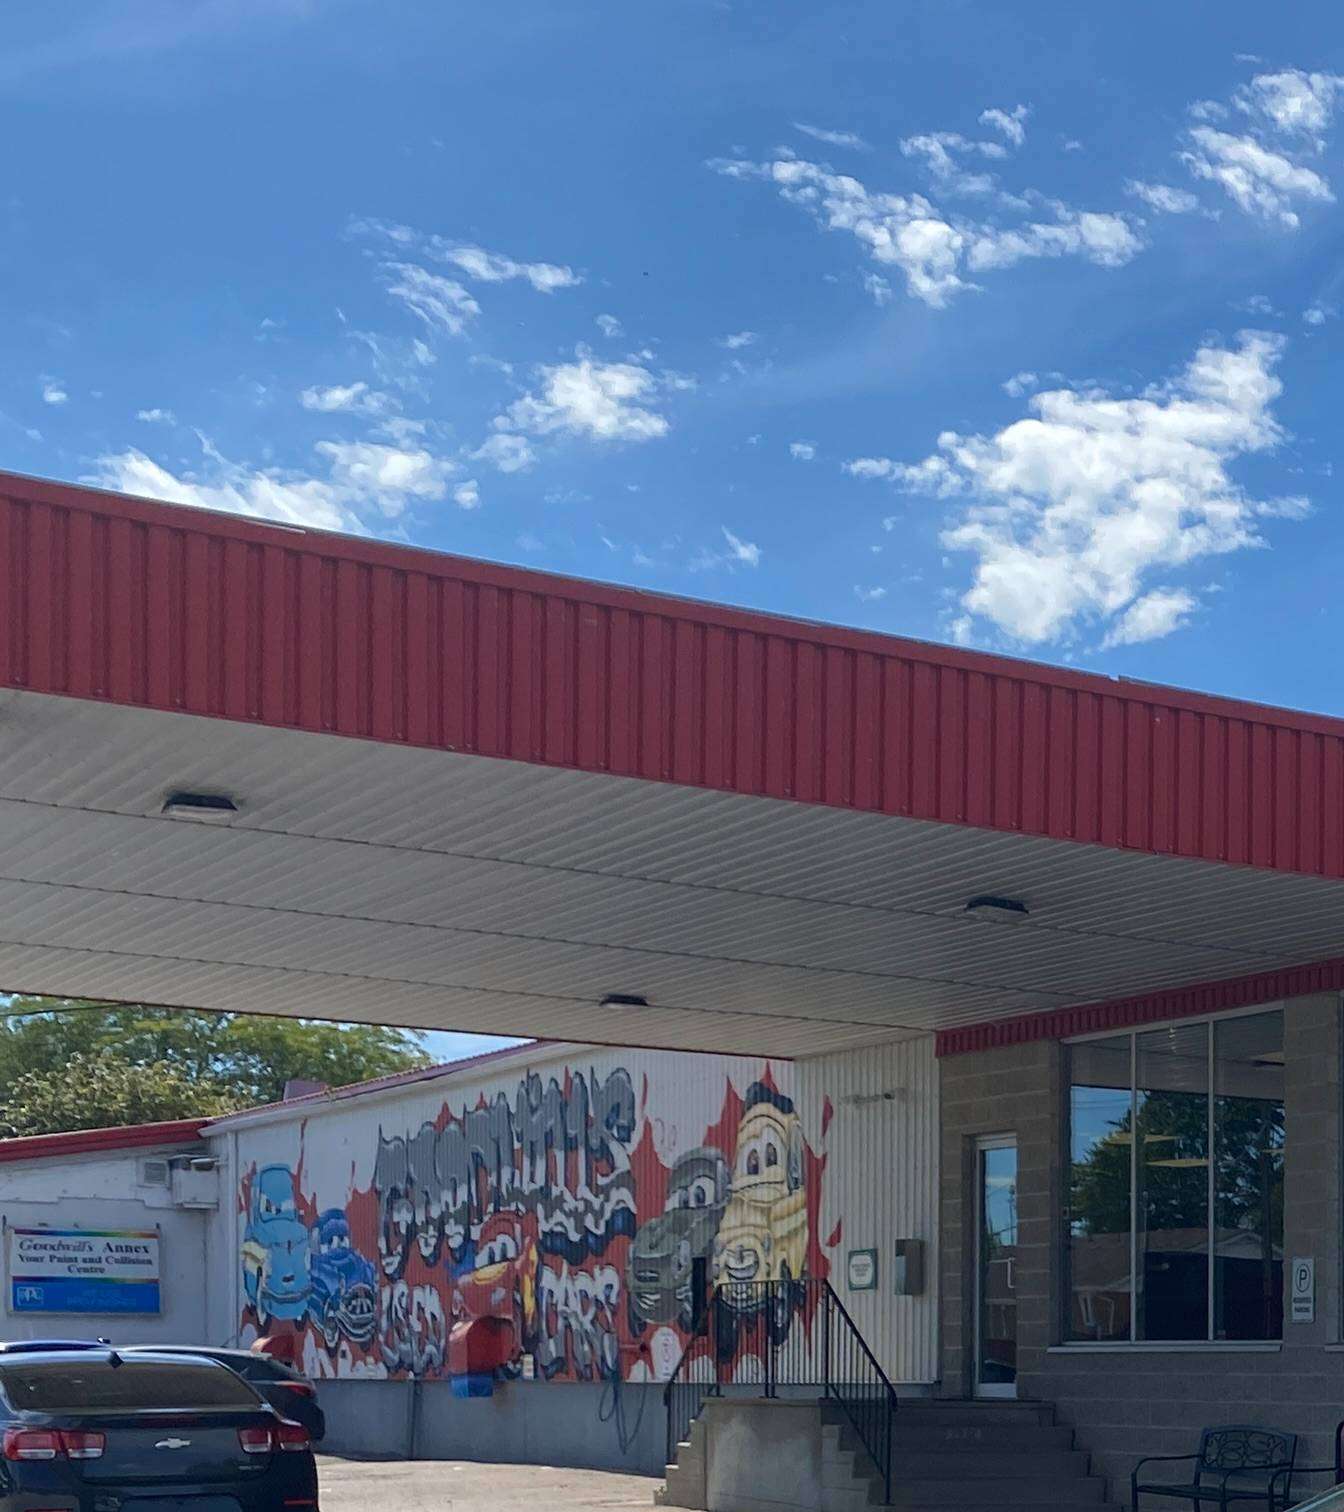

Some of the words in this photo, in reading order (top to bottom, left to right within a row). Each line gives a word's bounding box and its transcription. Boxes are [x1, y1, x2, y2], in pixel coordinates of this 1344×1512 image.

[103, 1242, 150, 1254] Annex
[18, 1253, 45, 1263] Your
[49, 1254, 79, 1264] Paint
[82, 1255, 103, 1264] and
[67, 1264, 106, 1274] Centre
